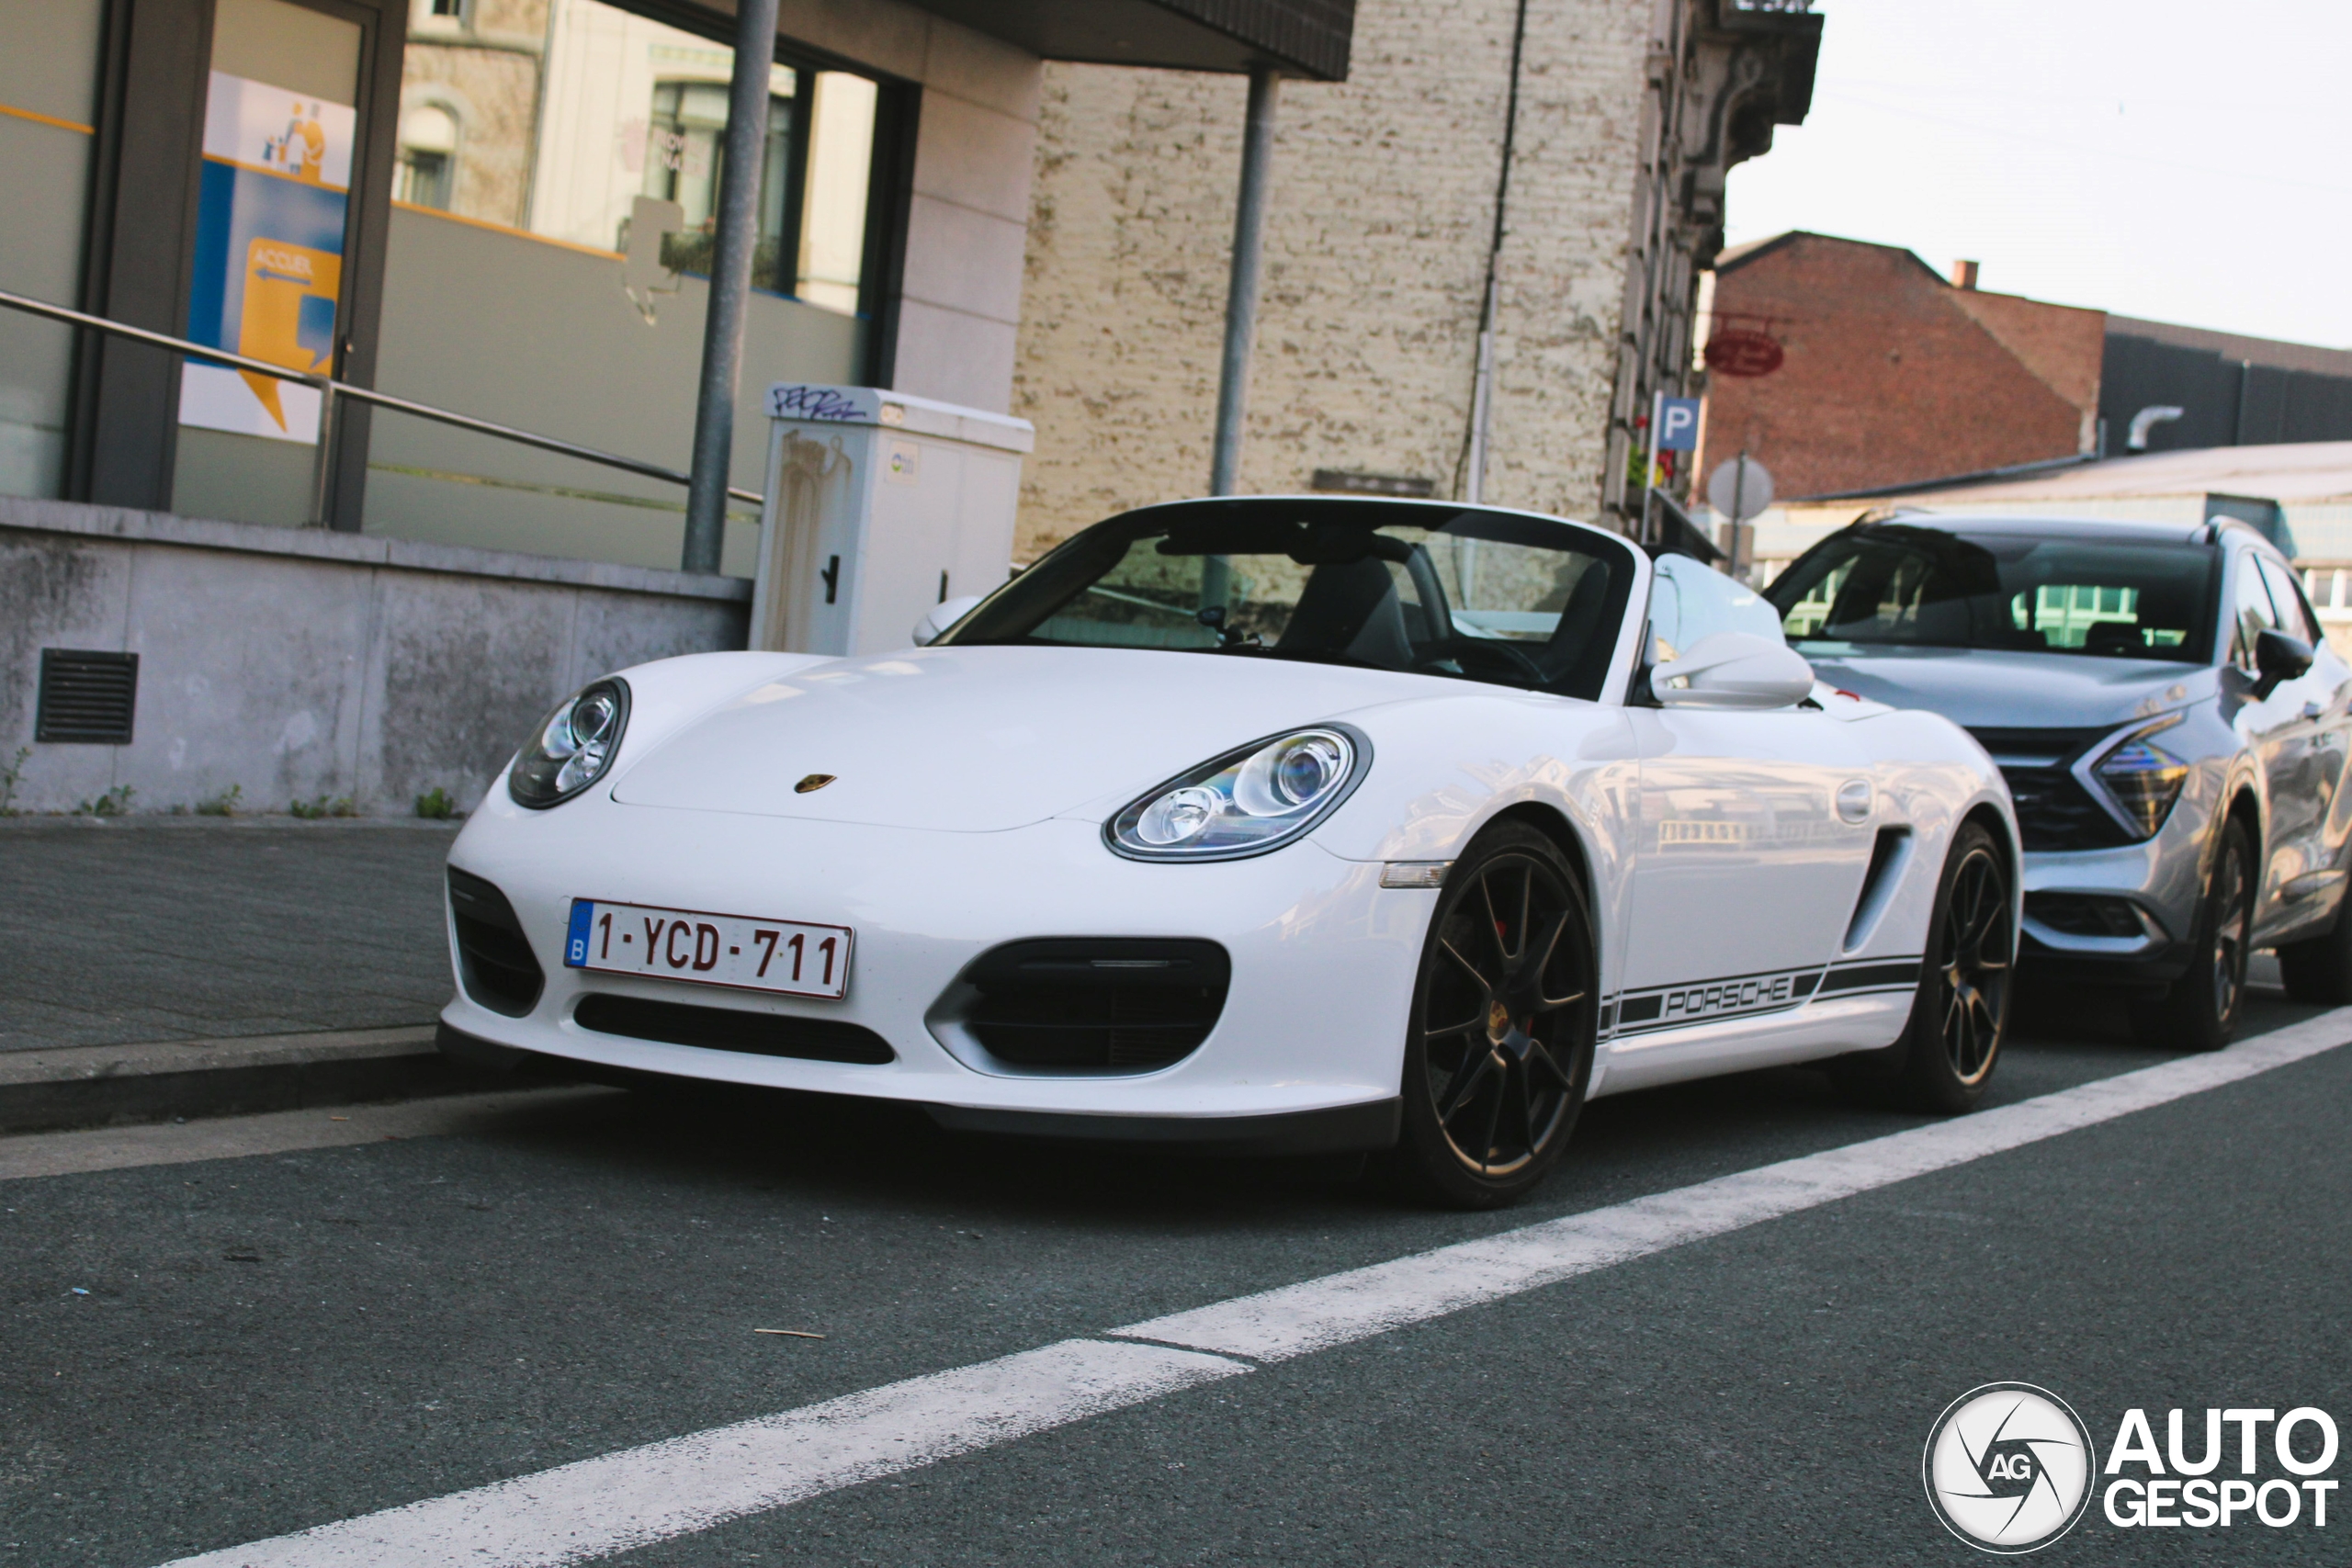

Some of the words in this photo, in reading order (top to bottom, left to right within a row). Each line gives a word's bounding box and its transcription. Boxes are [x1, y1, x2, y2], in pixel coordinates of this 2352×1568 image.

[1664, 405, 1692, 440] P
[571, 940, 584, 960] B
[599, 912, 836, 985] 1-YCD-711
[1666, 977, 1789, 1017] PORSCHE
